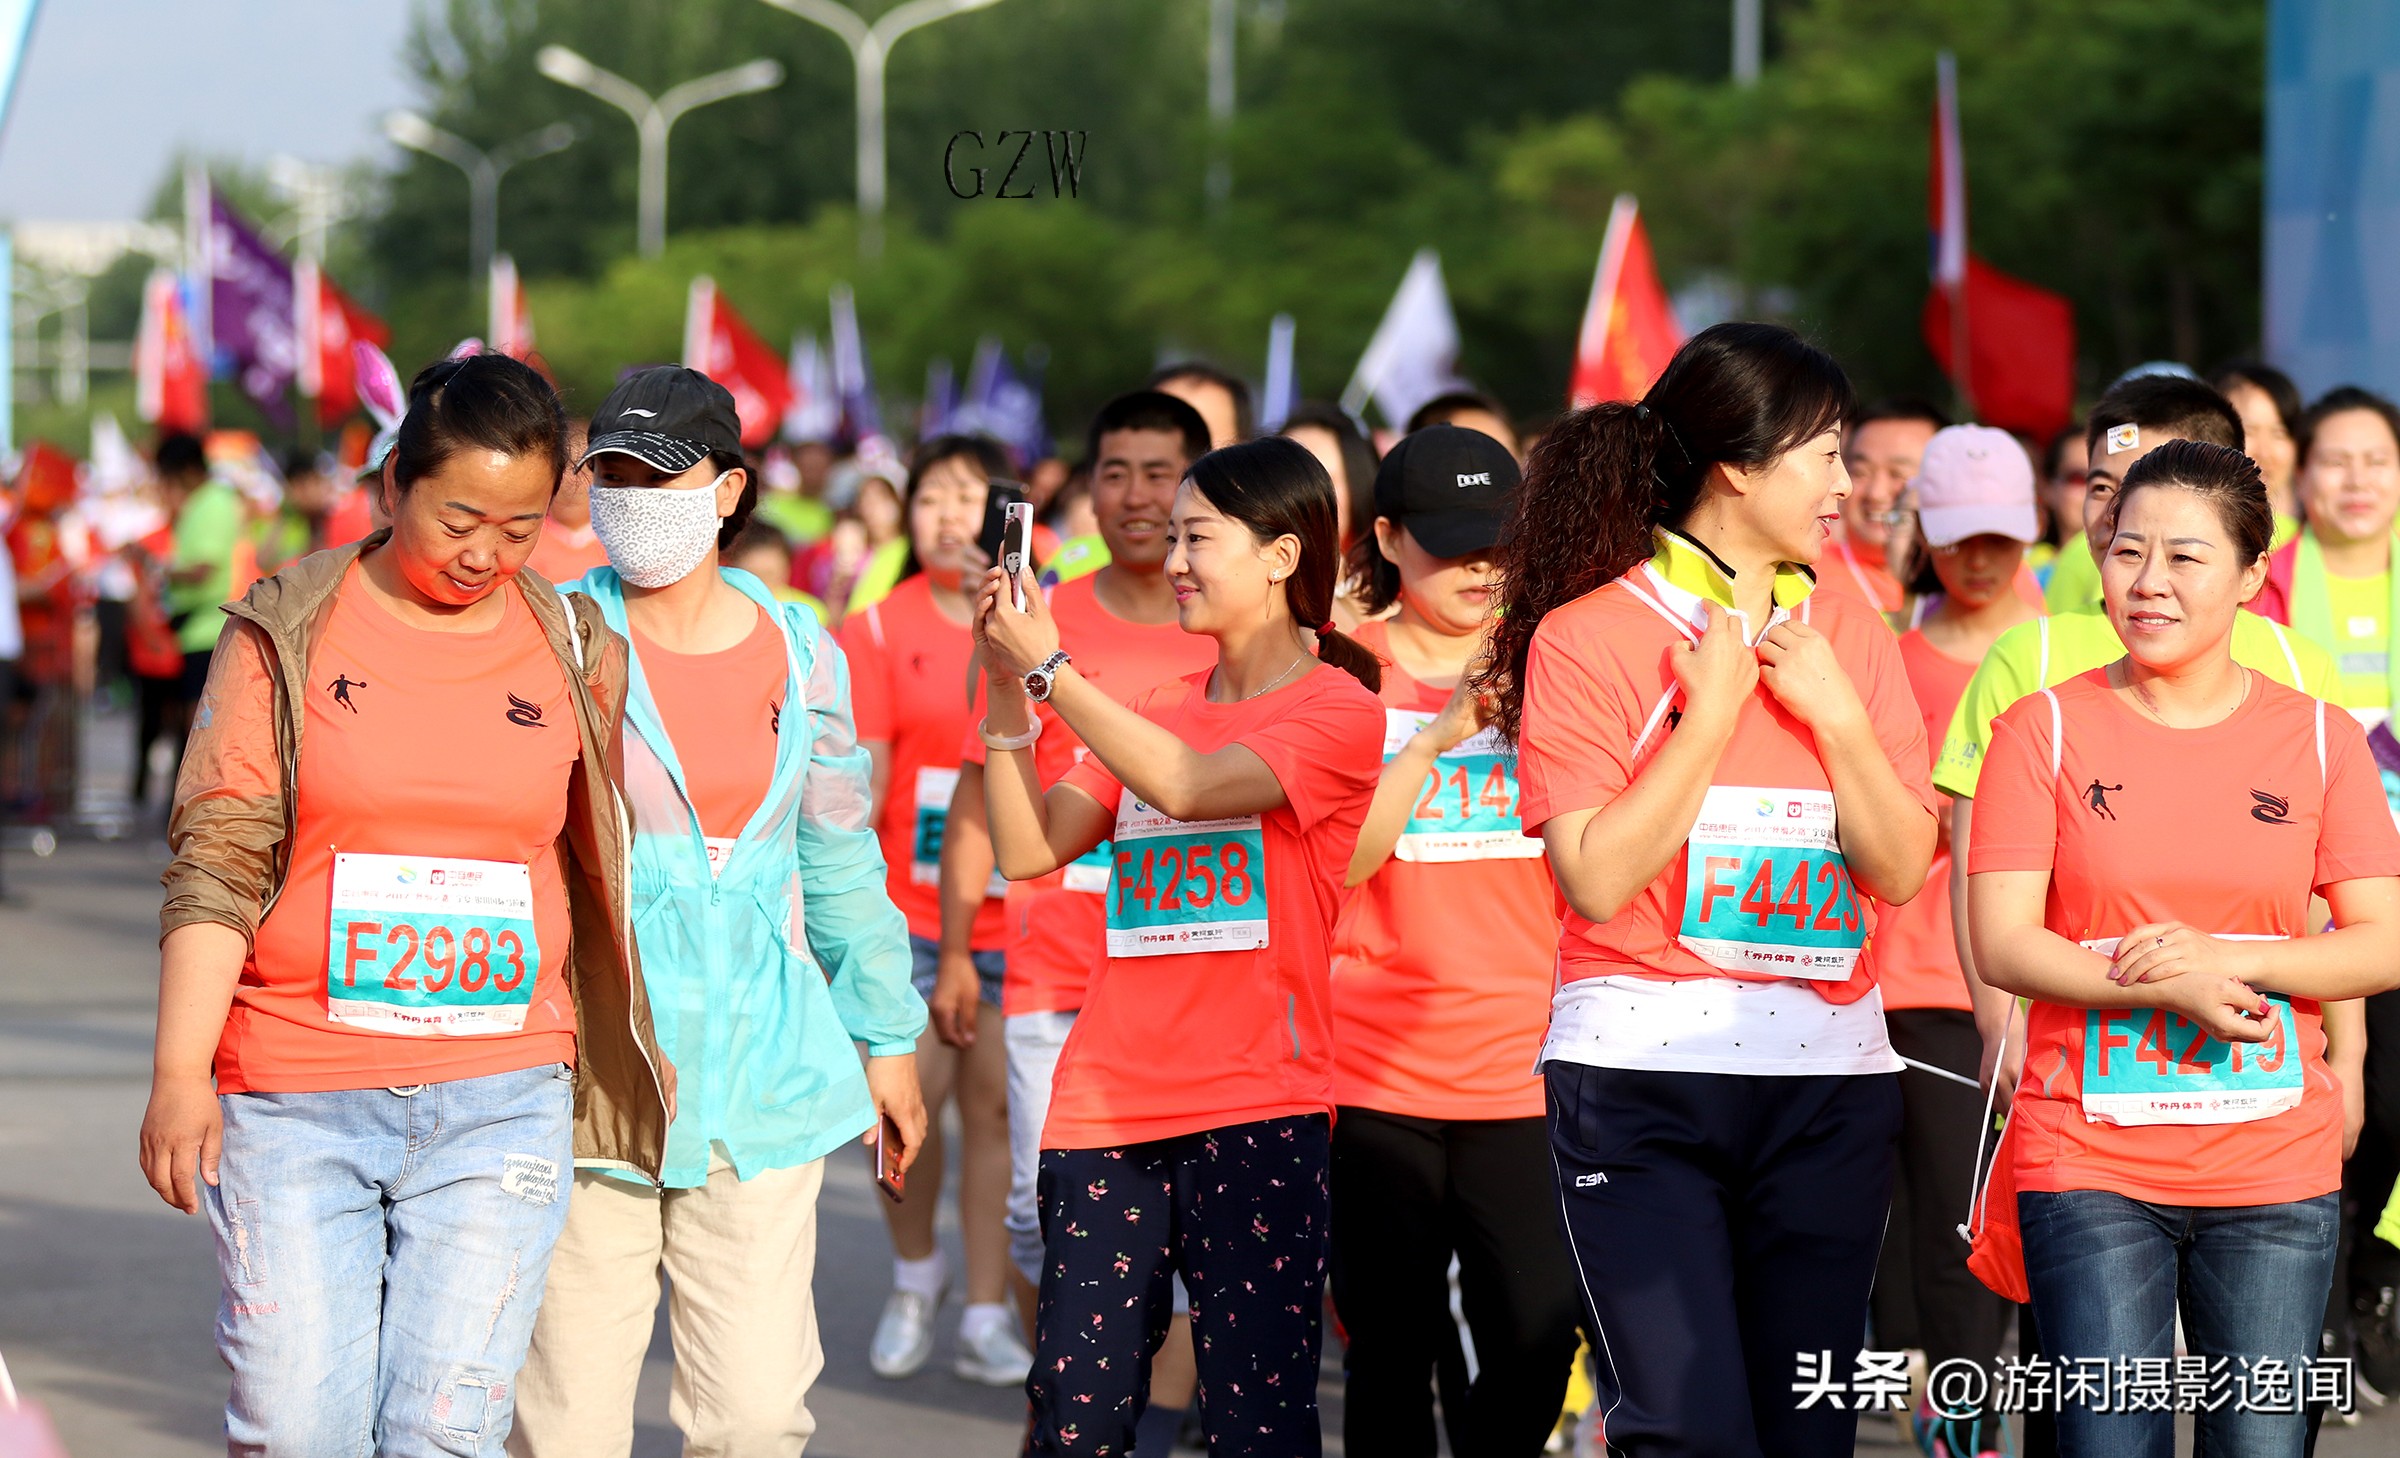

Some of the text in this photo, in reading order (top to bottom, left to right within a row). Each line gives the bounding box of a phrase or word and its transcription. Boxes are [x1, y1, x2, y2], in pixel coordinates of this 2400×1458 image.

[1456, 472, 1492, 488] DOPE
[1116, 841, 1253, 917] F4258
[1698, 855, 1861, 934] F4423
[343, 921, 526, 994] F2983
